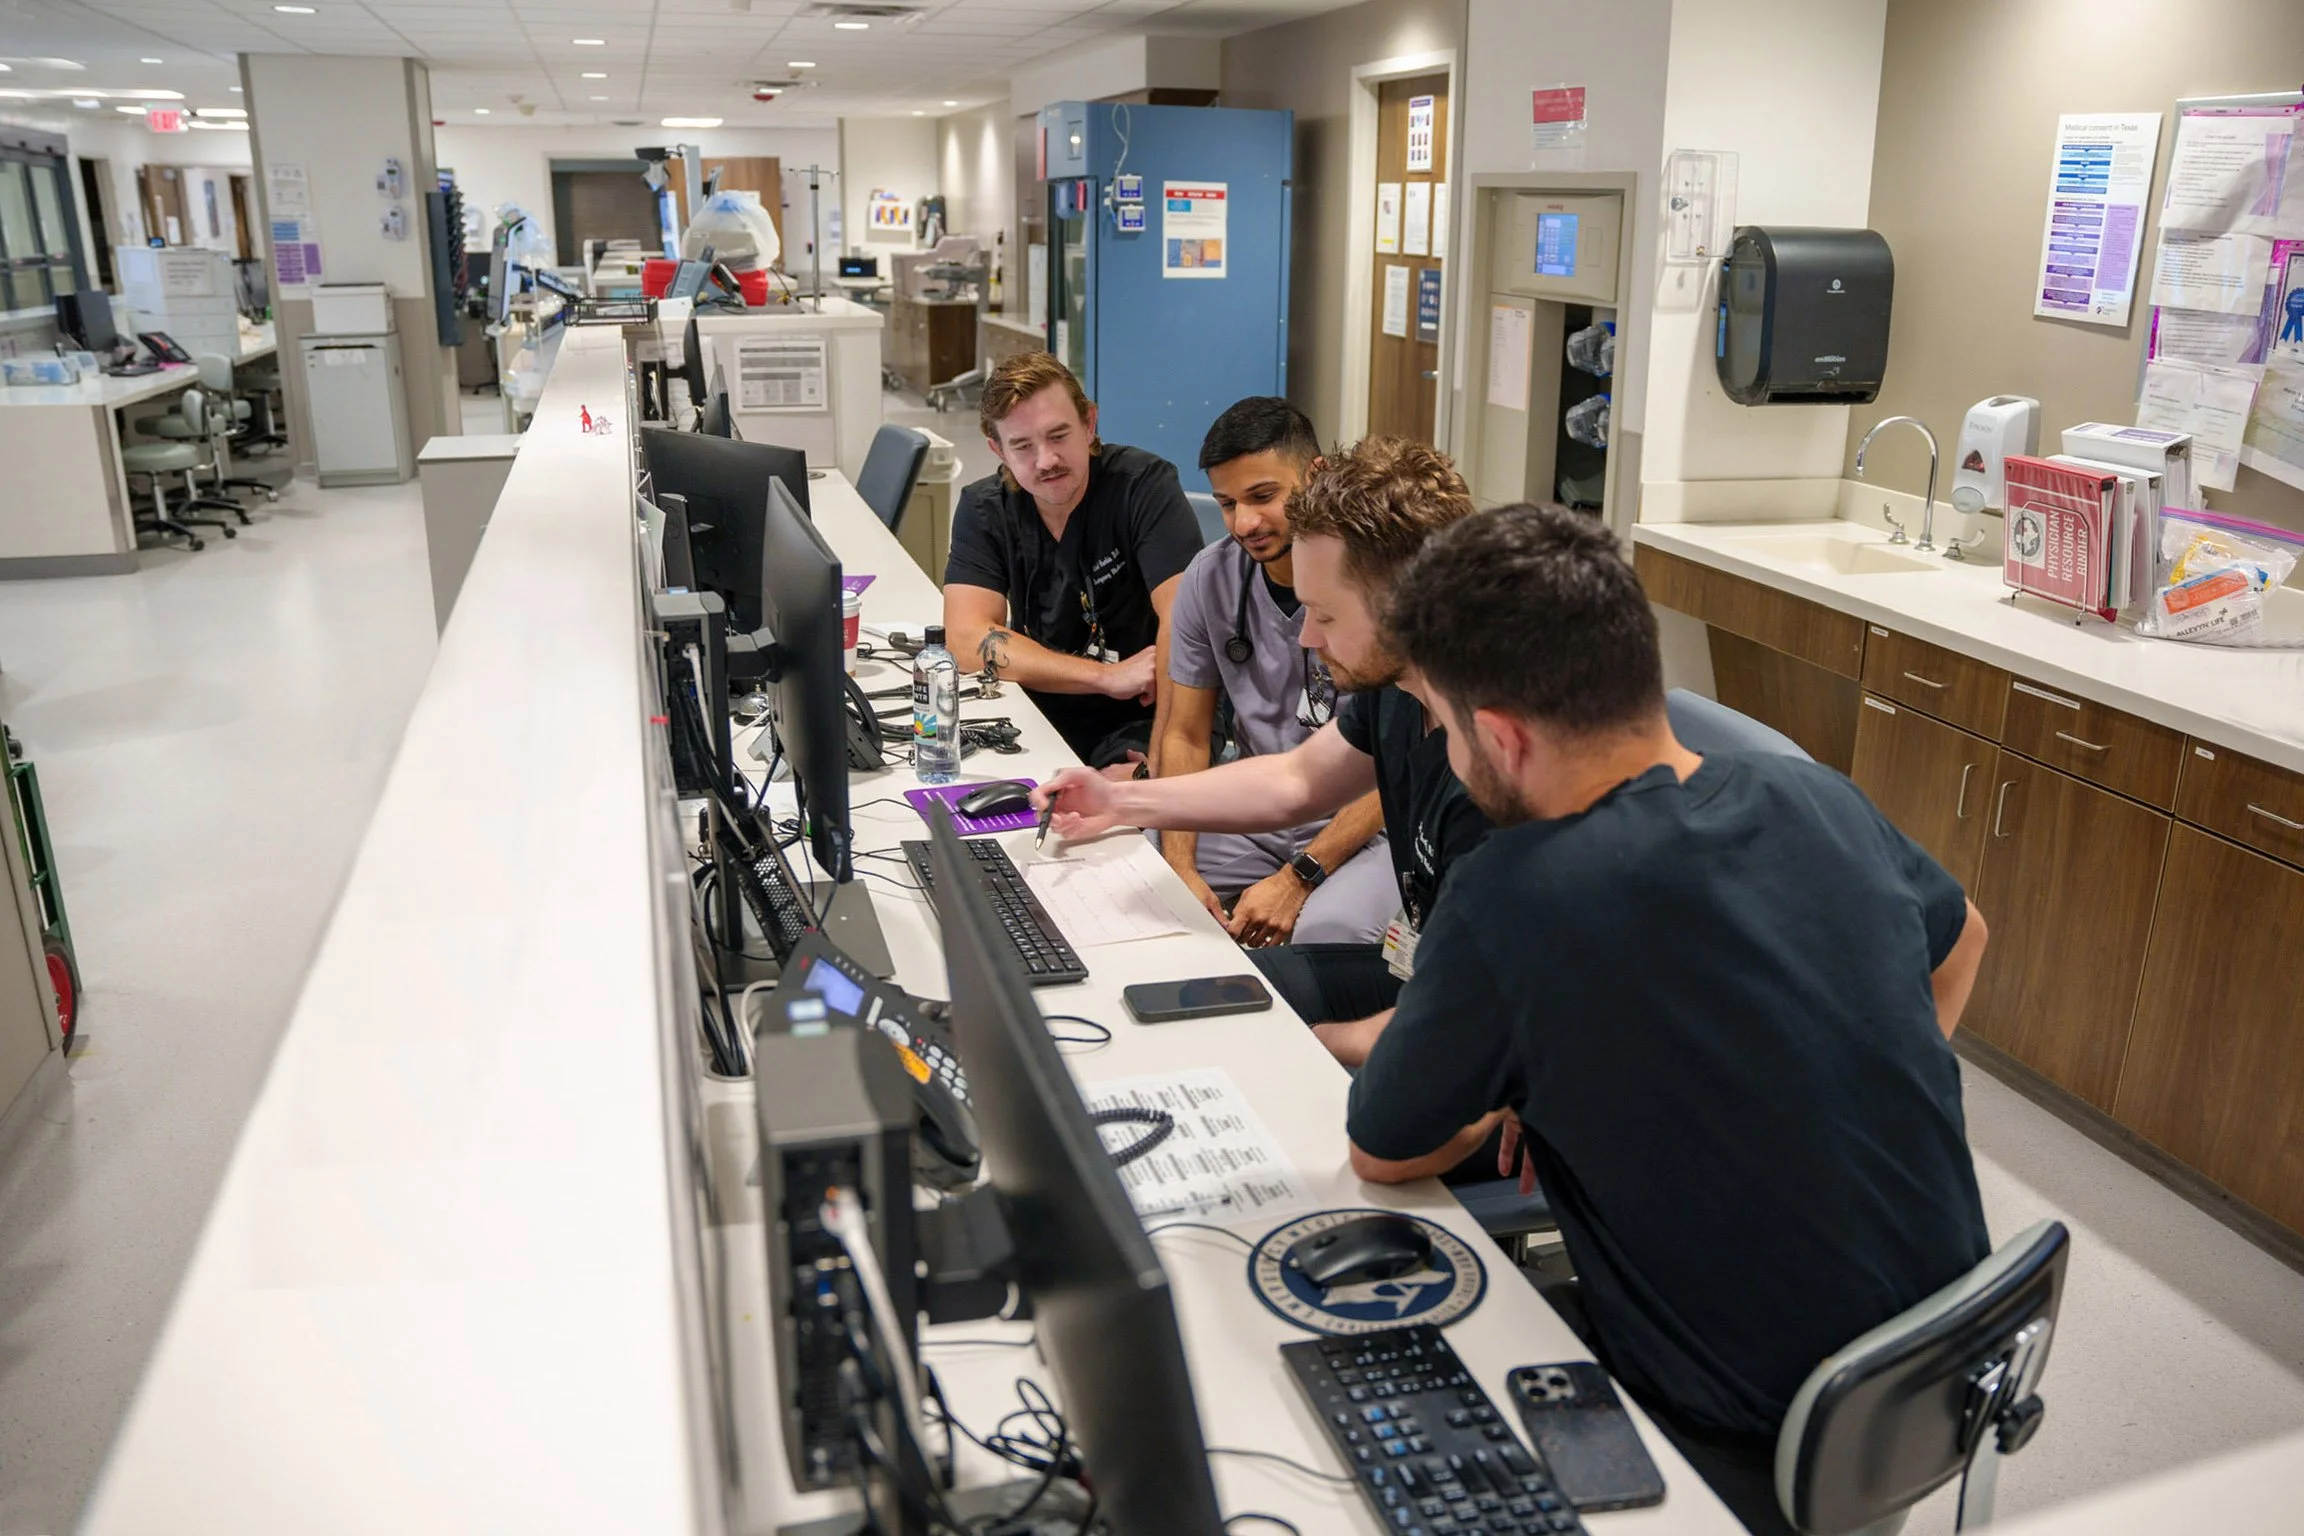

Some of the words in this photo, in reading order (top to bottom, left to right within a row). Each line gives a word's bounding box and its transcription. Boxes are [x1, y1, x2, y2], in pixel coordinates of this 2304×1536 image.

[2064, 123, 2087, 132] Medical
[2121, 122, 2138, 131] Texas
[2048, 510, 2061, 579] PHYSICIAN
[2062, 512, 2075, 583] RESOURCE
[2076, 528, 2088, 576] BINDER
[2176, 621, 2208, 637] ALLEVYN
[2211, 615, 2225, 626] LIFE
